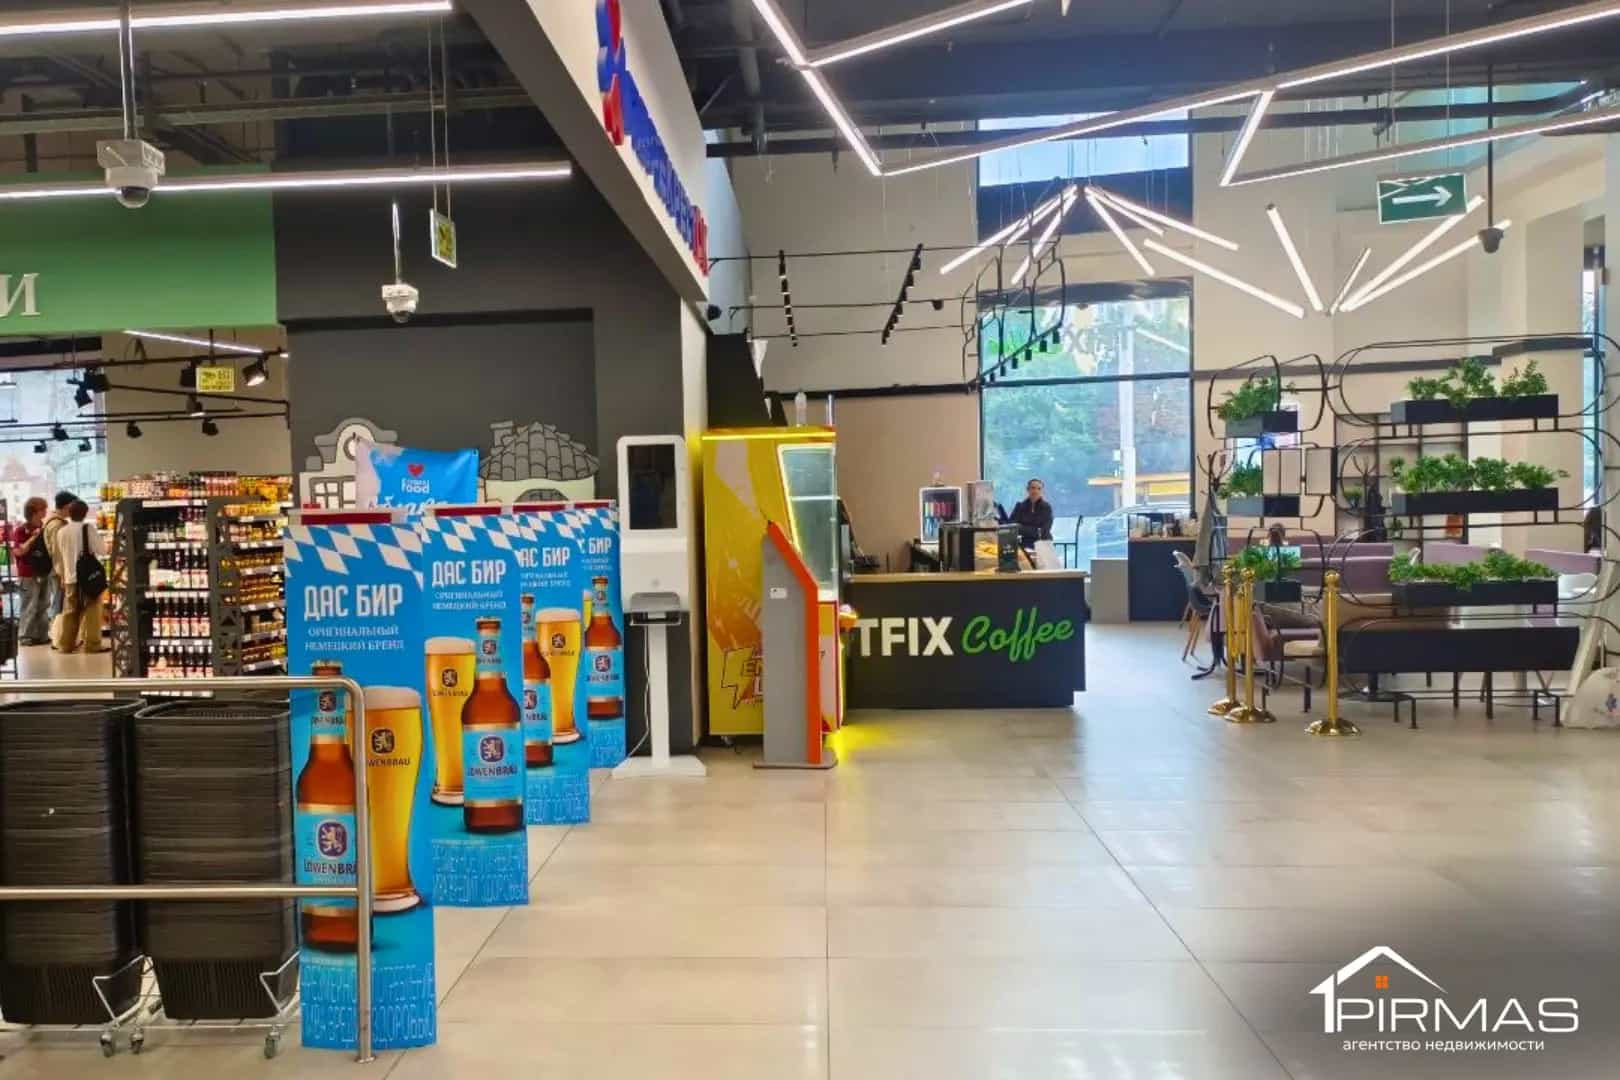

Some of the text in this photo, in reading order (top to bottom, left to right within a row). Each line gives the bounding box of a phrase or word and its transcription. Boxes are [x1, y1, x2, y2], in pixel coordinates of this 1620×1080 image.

[519, 547, 570, 567] АС БИР
[588, 537, 612, 554] БИР
[432, 559, 506, 588] ДАС БИР
[304, 584, 403, 621] ДАС БИР
[961, 607, 1075, 663] Coffee
